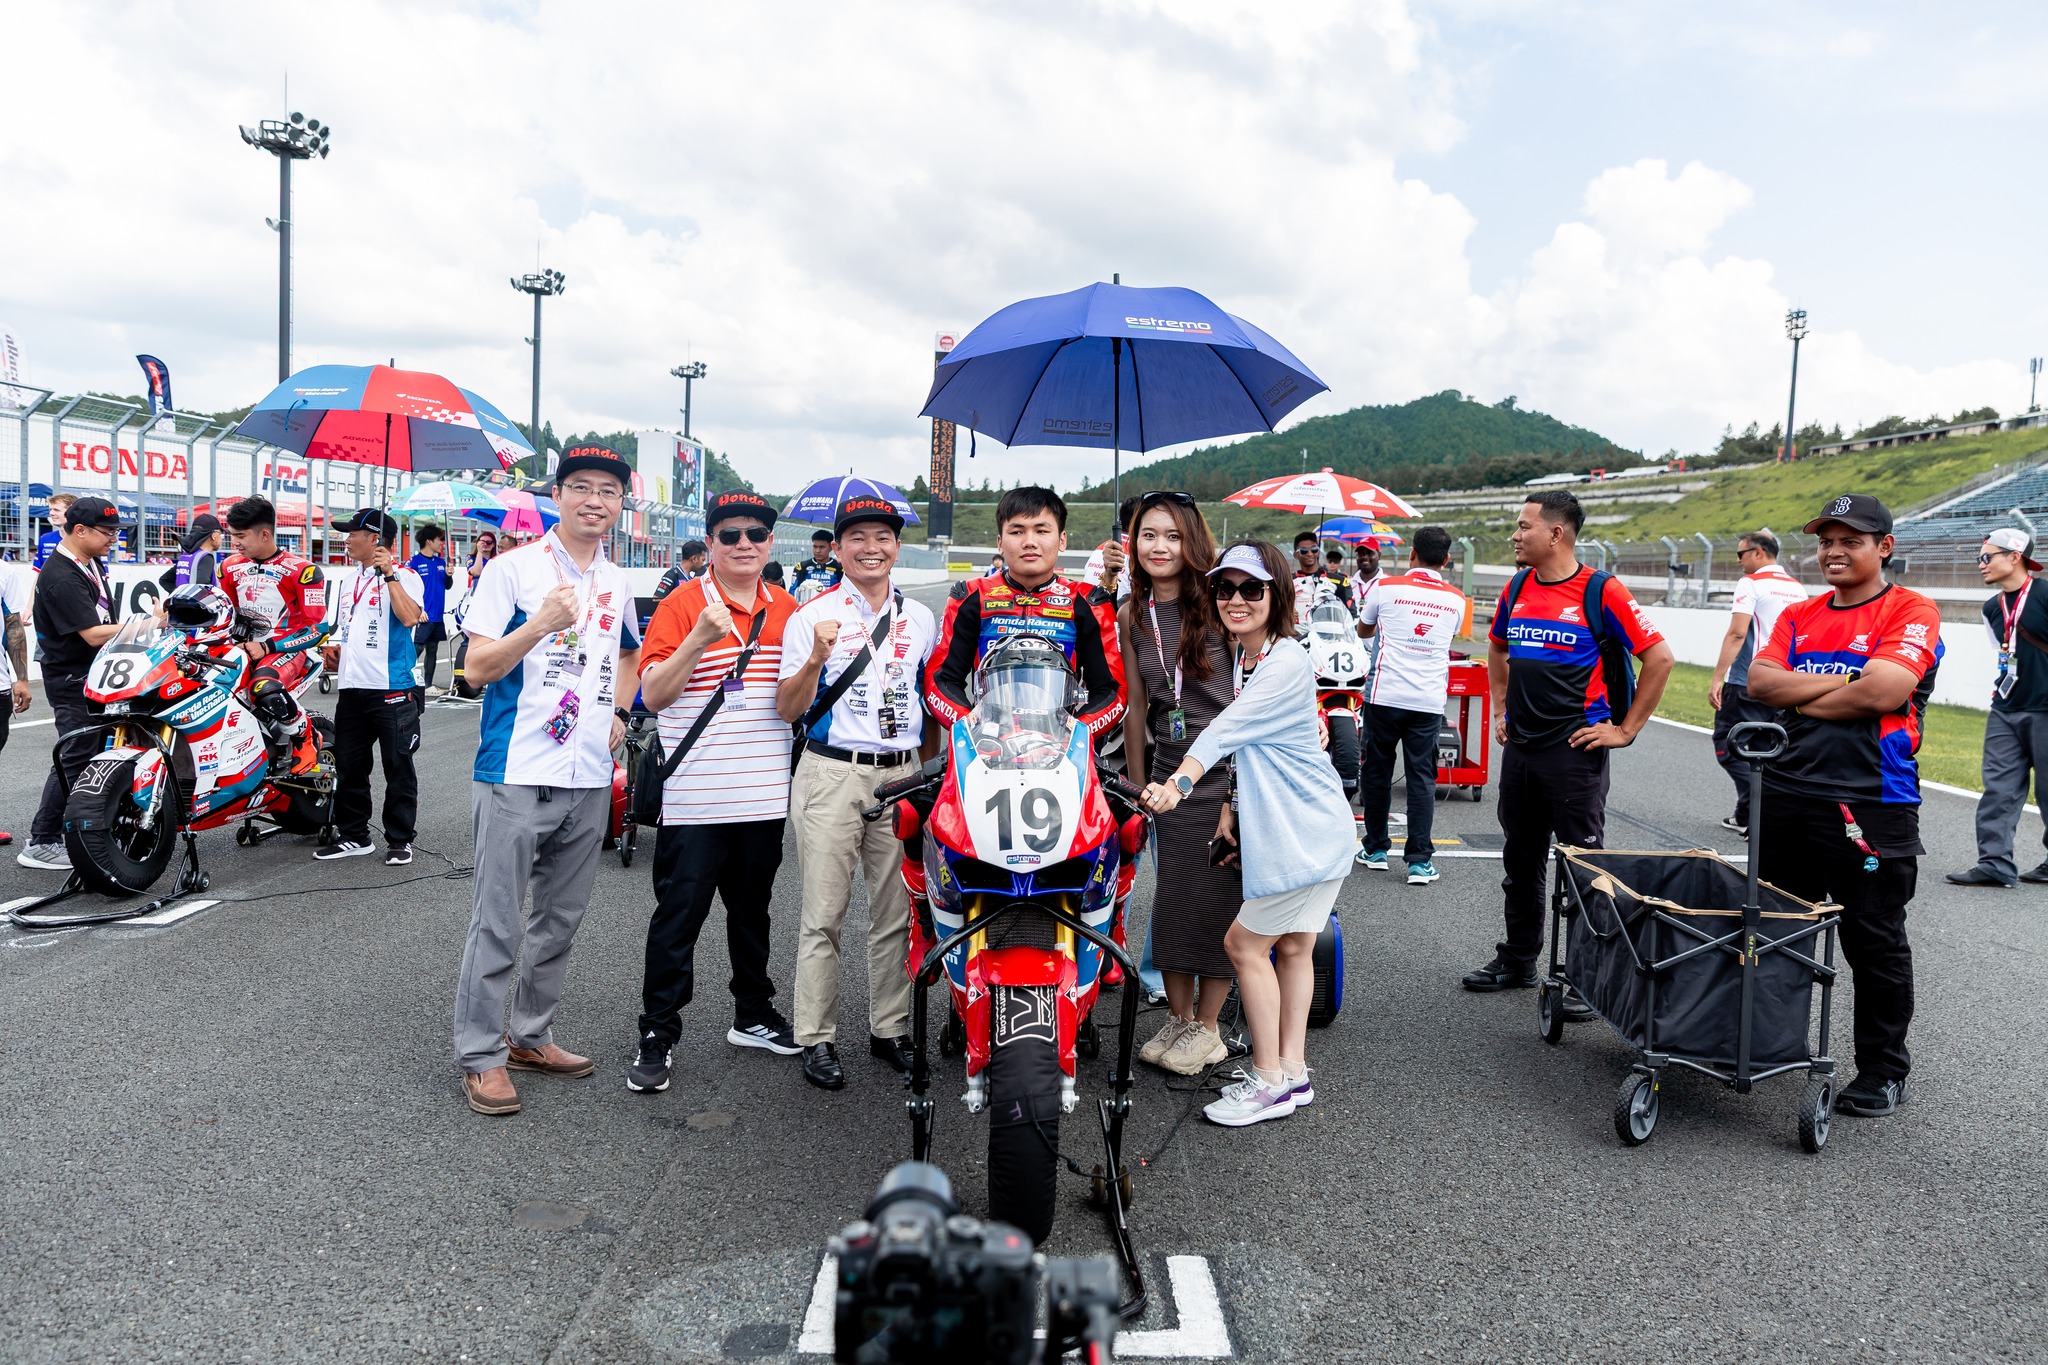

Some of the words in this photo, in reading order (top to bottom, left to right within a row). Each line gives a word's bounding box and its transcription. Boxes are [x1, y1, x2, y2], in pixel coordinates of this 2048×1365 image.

[1125, 316, 1212, 331] estremo
[59, 442, 193, 480] HONDA
[569, 447, 620, 460] Honda
[316, 477, 366, 495] Honda
[718, 494, 765, 506] Honda
[845, 500, 892, 514] Honda
[1831, 497, 1852, 515] B
[1394, 599, 1426, 608] Honda
[1427, 602, 1457, 615] Racing
[1412, 609, 1439, 618] India
[991, 617, 1026, 626] Honda
[1027, 618, 1065, 630] Racing
[1008, 627, 1056, 636] Vietnam
[284, 631, 321, 648] HONDA
[1407, 636, 1435, 646] idemitsu
[600, 665, 612, 674] RK
[1328, 652, 1354, 673] 13
[98, 659, 135, 690] 18
[171, 701, 202, 722] Honda
[190, 693, 226, 720] Vietnam
[928, 691, 957, 723] HONDA
[1088, 702, 1124, 734] HONDA
[198, 752, 218, 762] RK
[247, 788, 269, 808] 18
[985, 787, 1063, 853] 19
